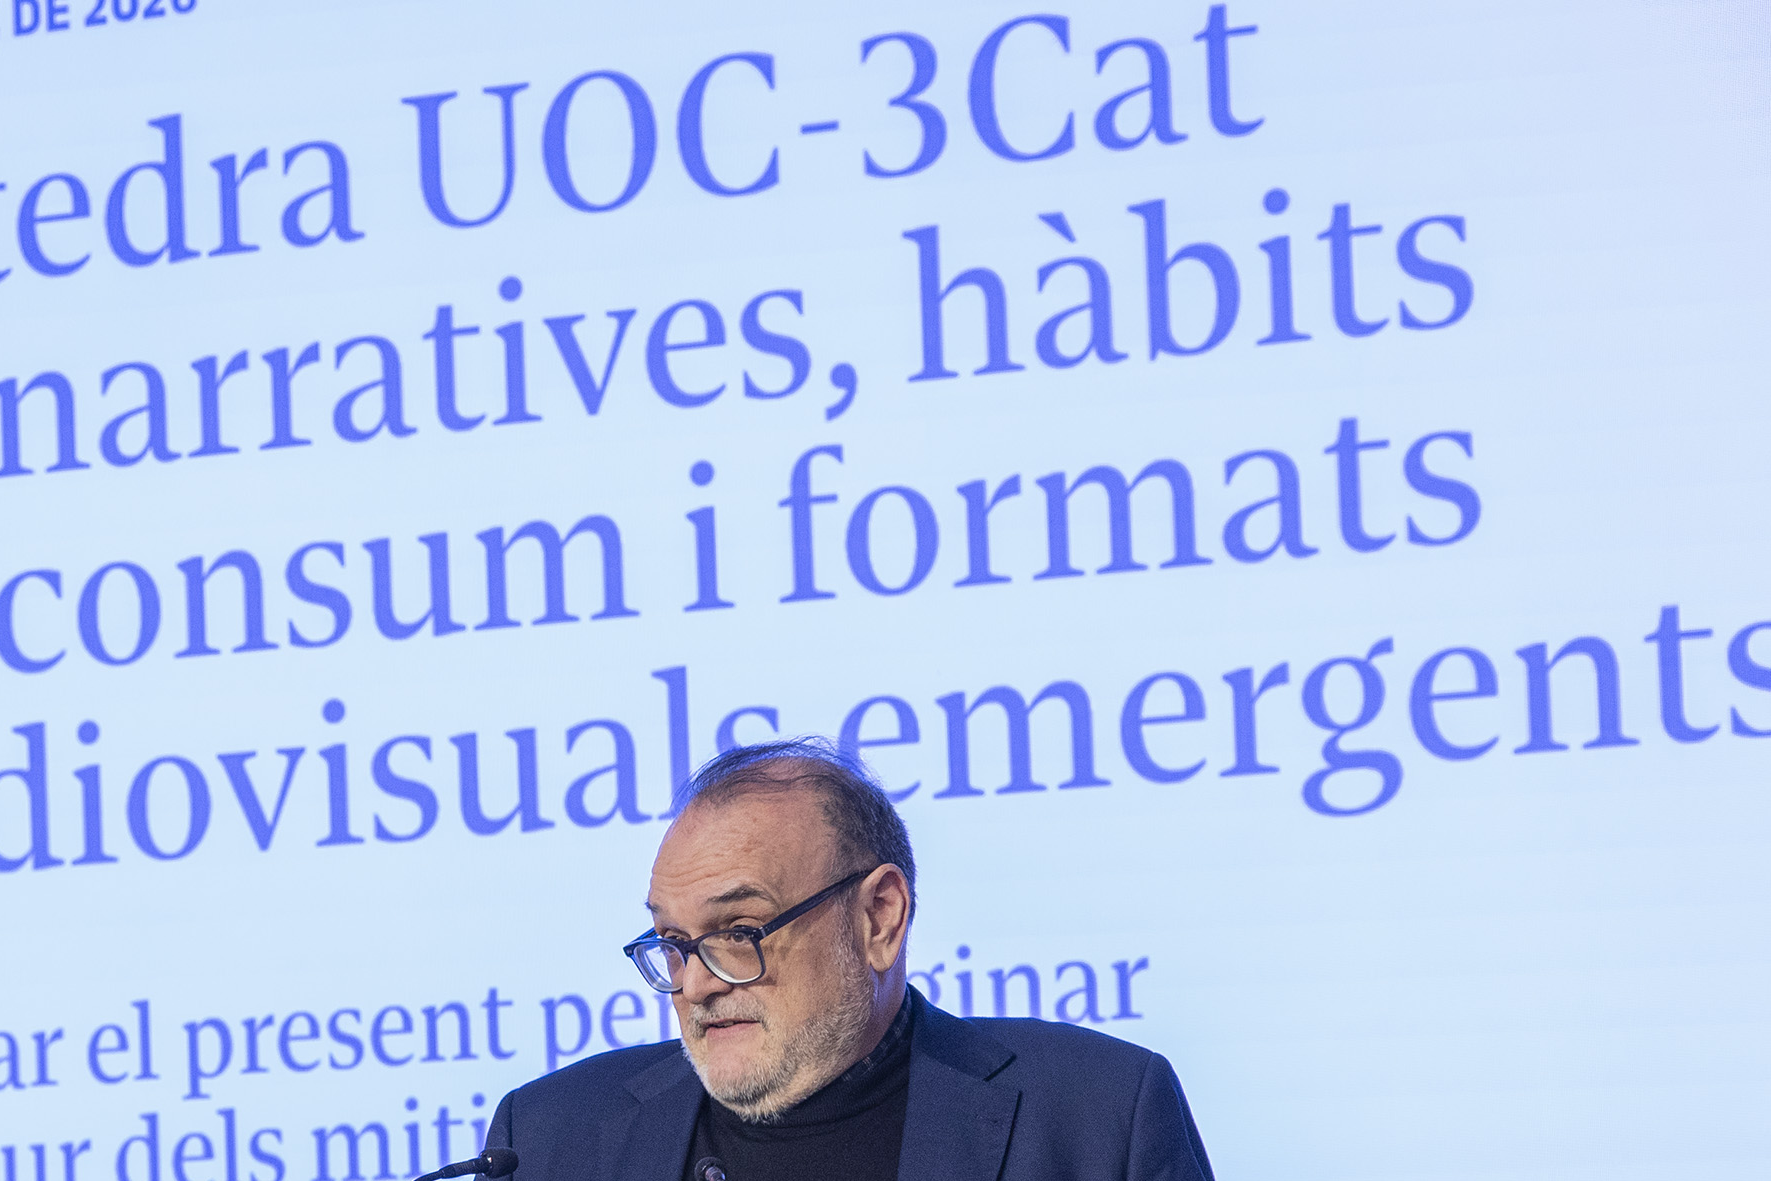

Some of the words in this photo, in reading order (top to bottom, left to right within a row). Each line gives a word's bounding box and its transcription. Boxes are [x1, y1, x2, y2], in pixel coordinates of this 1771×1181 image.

[11, 0, 72, 38] DE
[400, 3, 1266, 229] UOC-3Cat
[901, 187, 1475, 383] hàbits
[683, 460, 736, 613] i
[777, 417, 1483, 604] formats
[87, 999, 160, 1085] el
[182, 986, 517, 1101] present
